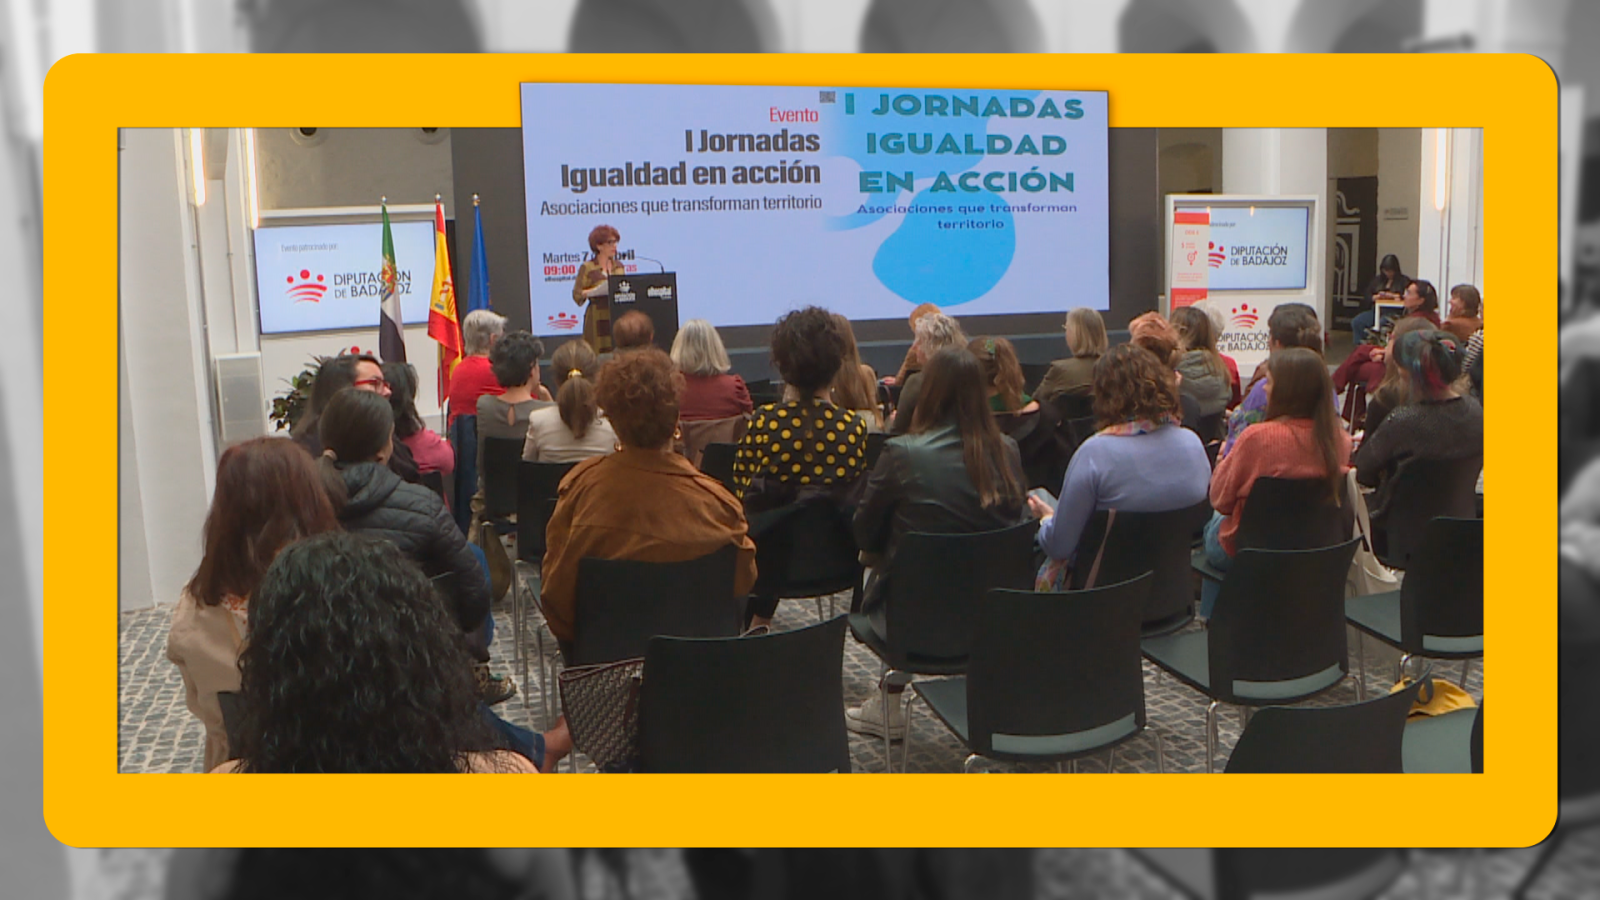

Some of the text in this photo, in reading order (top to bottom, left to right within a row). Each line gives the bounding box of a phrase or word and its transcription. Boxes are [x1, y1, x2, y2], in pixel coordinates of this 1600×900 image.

[769, 106, 819, 122] Evento
[845, 93, 1085, 119] I JORNADAS
[685, 129, 820, 152] I Jornadas
[866, 132, 1067, 155] IGUALDAD
[561, 160, 821, 193] Igualdad en acción
[859, 166, 1075, 193] EN ACCIÓN
[540, 194, 822, 216] Asociaciones que transforman territorio
[856, 202, 1077, 216] Asociaciones que transforman
[937, 218, 1004, 229] territorio
[1230, 242, 1288, 256] DIPUTACIÓN
[543, 251, 580, 264] Martes
[581, 251, 589, 262] 7
[1230, 255, 1287, 266] DE BADAJOZ
[544, 264, 576, 275] 09:00
[334, 270, 411, 286] DIPUTACN
[334, 282, 412, 299] DE BADOZ
